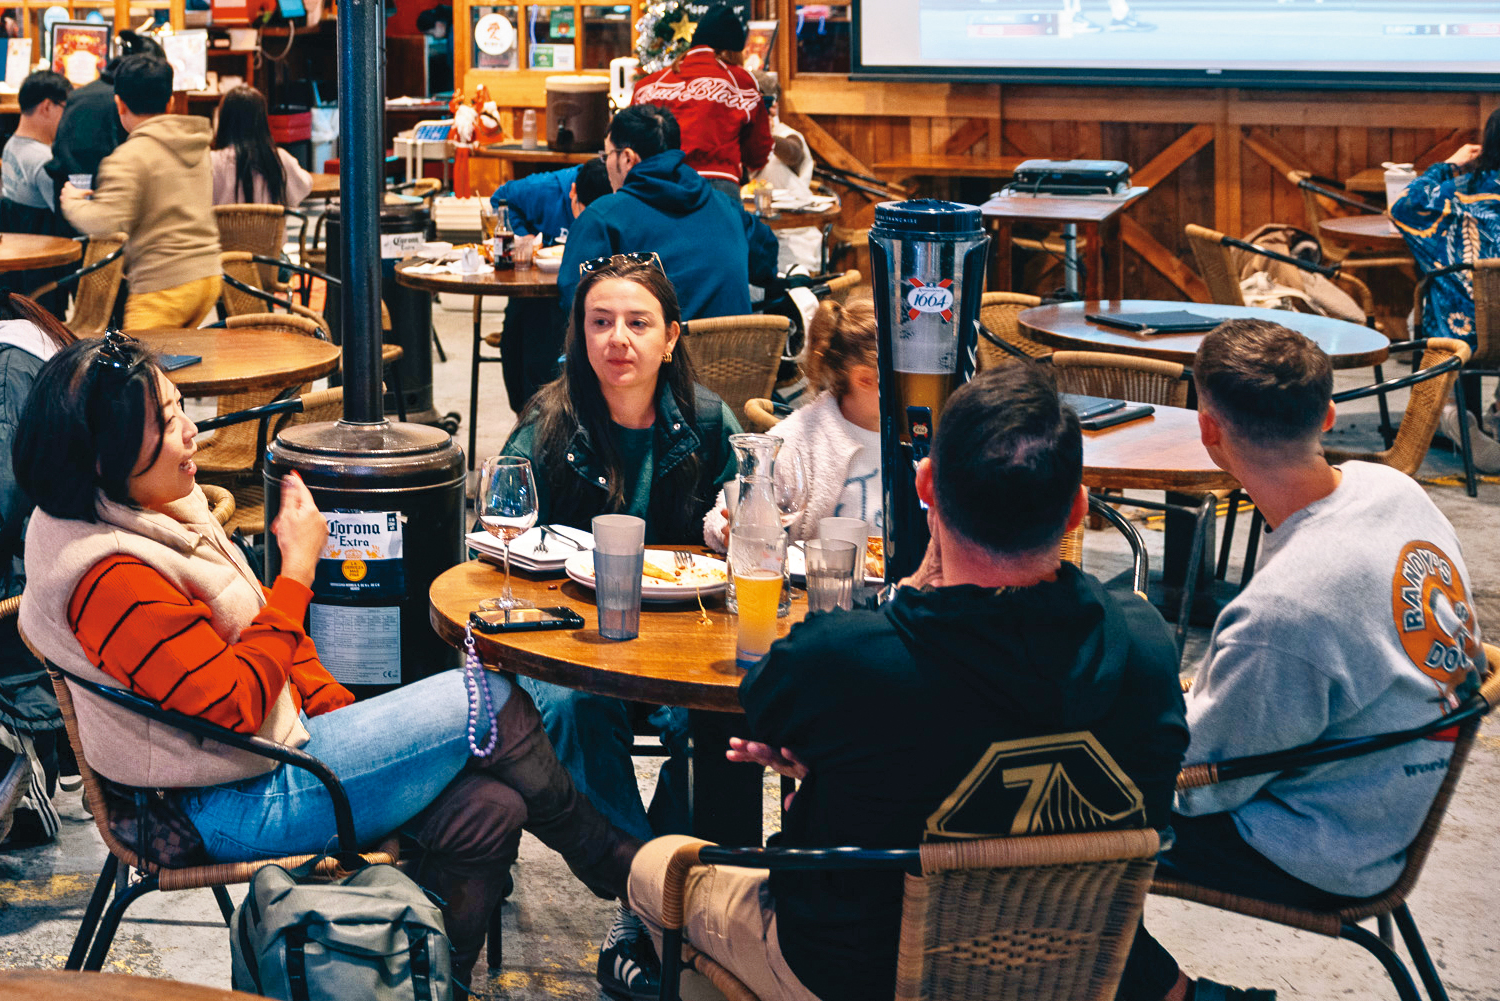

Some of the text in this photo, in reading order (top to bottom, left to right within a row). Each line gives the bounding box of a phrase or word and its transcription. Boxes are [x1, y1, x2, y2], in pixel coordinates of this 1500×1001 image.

[913, 291, 947, 309] 1664
[327, 519, 380, 539] Corona
[339, 536, 369, 547] Extra
[1402, 548, 1452, 632] RANDY'S
